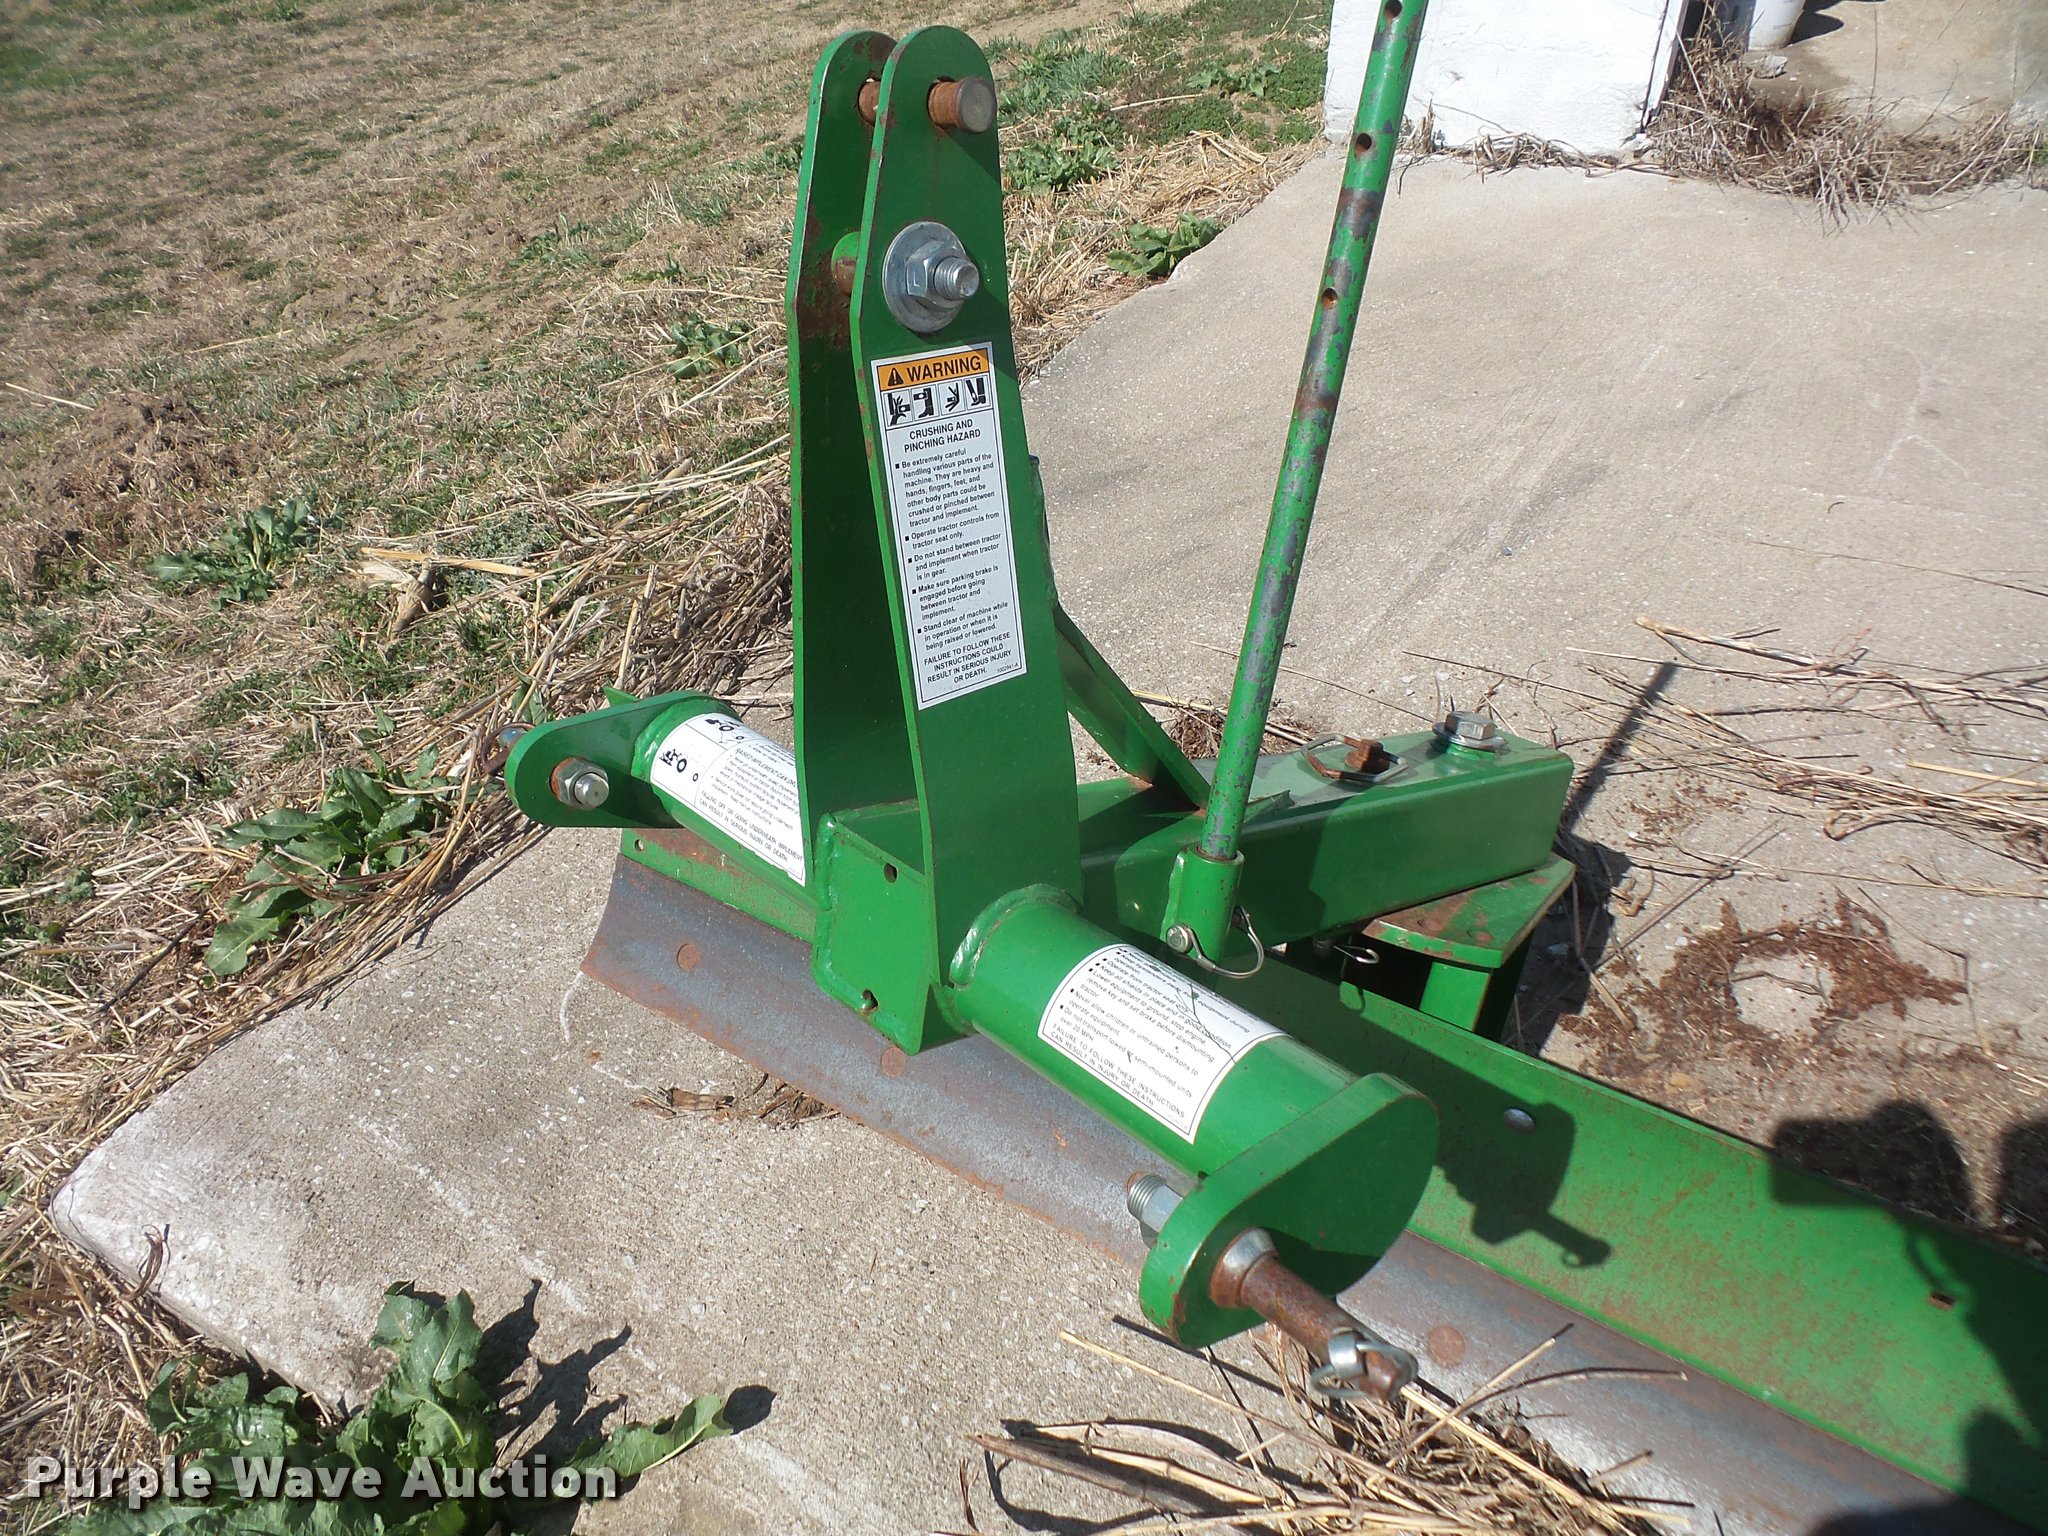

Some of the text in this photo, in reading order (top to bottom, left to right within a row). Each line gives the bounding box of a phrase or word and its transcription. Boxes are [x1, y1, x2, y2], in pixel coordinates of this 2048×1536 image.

[906, 355, 982, 382] WARNING
[904, 428, 981, 453] PINCHING HAZARD
[909, 418, 973, 440] CRUSHING AND
[901, 447, 967, 469] Be extremely careful
[902, 453, 992, 479] handling various parts of the
[934, 472, 950, 481] They
[951, 470, 962, 478] are
[962, 465, 981, 475] heavy
[982, 461, 994, 470] and
[968, 473, 981, 483] and
[906, 483, 986, 508] other body parts could be
[908, 504, 935, 518] crushed
[943, 496, 969, 510] pinched
[969, 491, 995, 502] between
[909, 516, 931, 528] tractor
[932, 512, 944, 522] and
[910, 512, 1000, 540] Operate tractor controls from
[912, 538, 934, 550] tractor
[934, 534, 949, 544] seat
[913, 533, 1001, 562] Do not stand between tractor
[915, 543, 999, 572] and implement when tractor
[918, 583, 935, 593] Make
[935, 579, 950, 588] sure
[951, 572, 974, 585] parking
[974, 567, 992, 577] brake
[919, 578, 986, 602] engaged before going
[920, 587, 981, 612] between tractor and
[923, 601, 1008, 633] Stand clear of machine while
[924, 634, 931, 642] in
[931, 625, 962, 640] operation
[962, 622, 969, 630] or
[969, 617, 986, 627] when
[923, 631, 1011, 666] FAILURE TO FOLLOW THESE
[925, 640, 944, 651] being
[944, 632, 964, 645] raised
[964, 631, 971, 639] or
[927, 669, 952, 684] RESULT
[953, 666, 960, 675] IN
[960, 656, 989, 672] SERIOUS
[989, 648, 1012, 662] INJURY
[933, 650, 981, 672] INSTRUCTIONS
[981, 642, 1004, 656] COULD
[953, 674, 964, 684] OR
[1190, 1068, 1199, 1076] to
